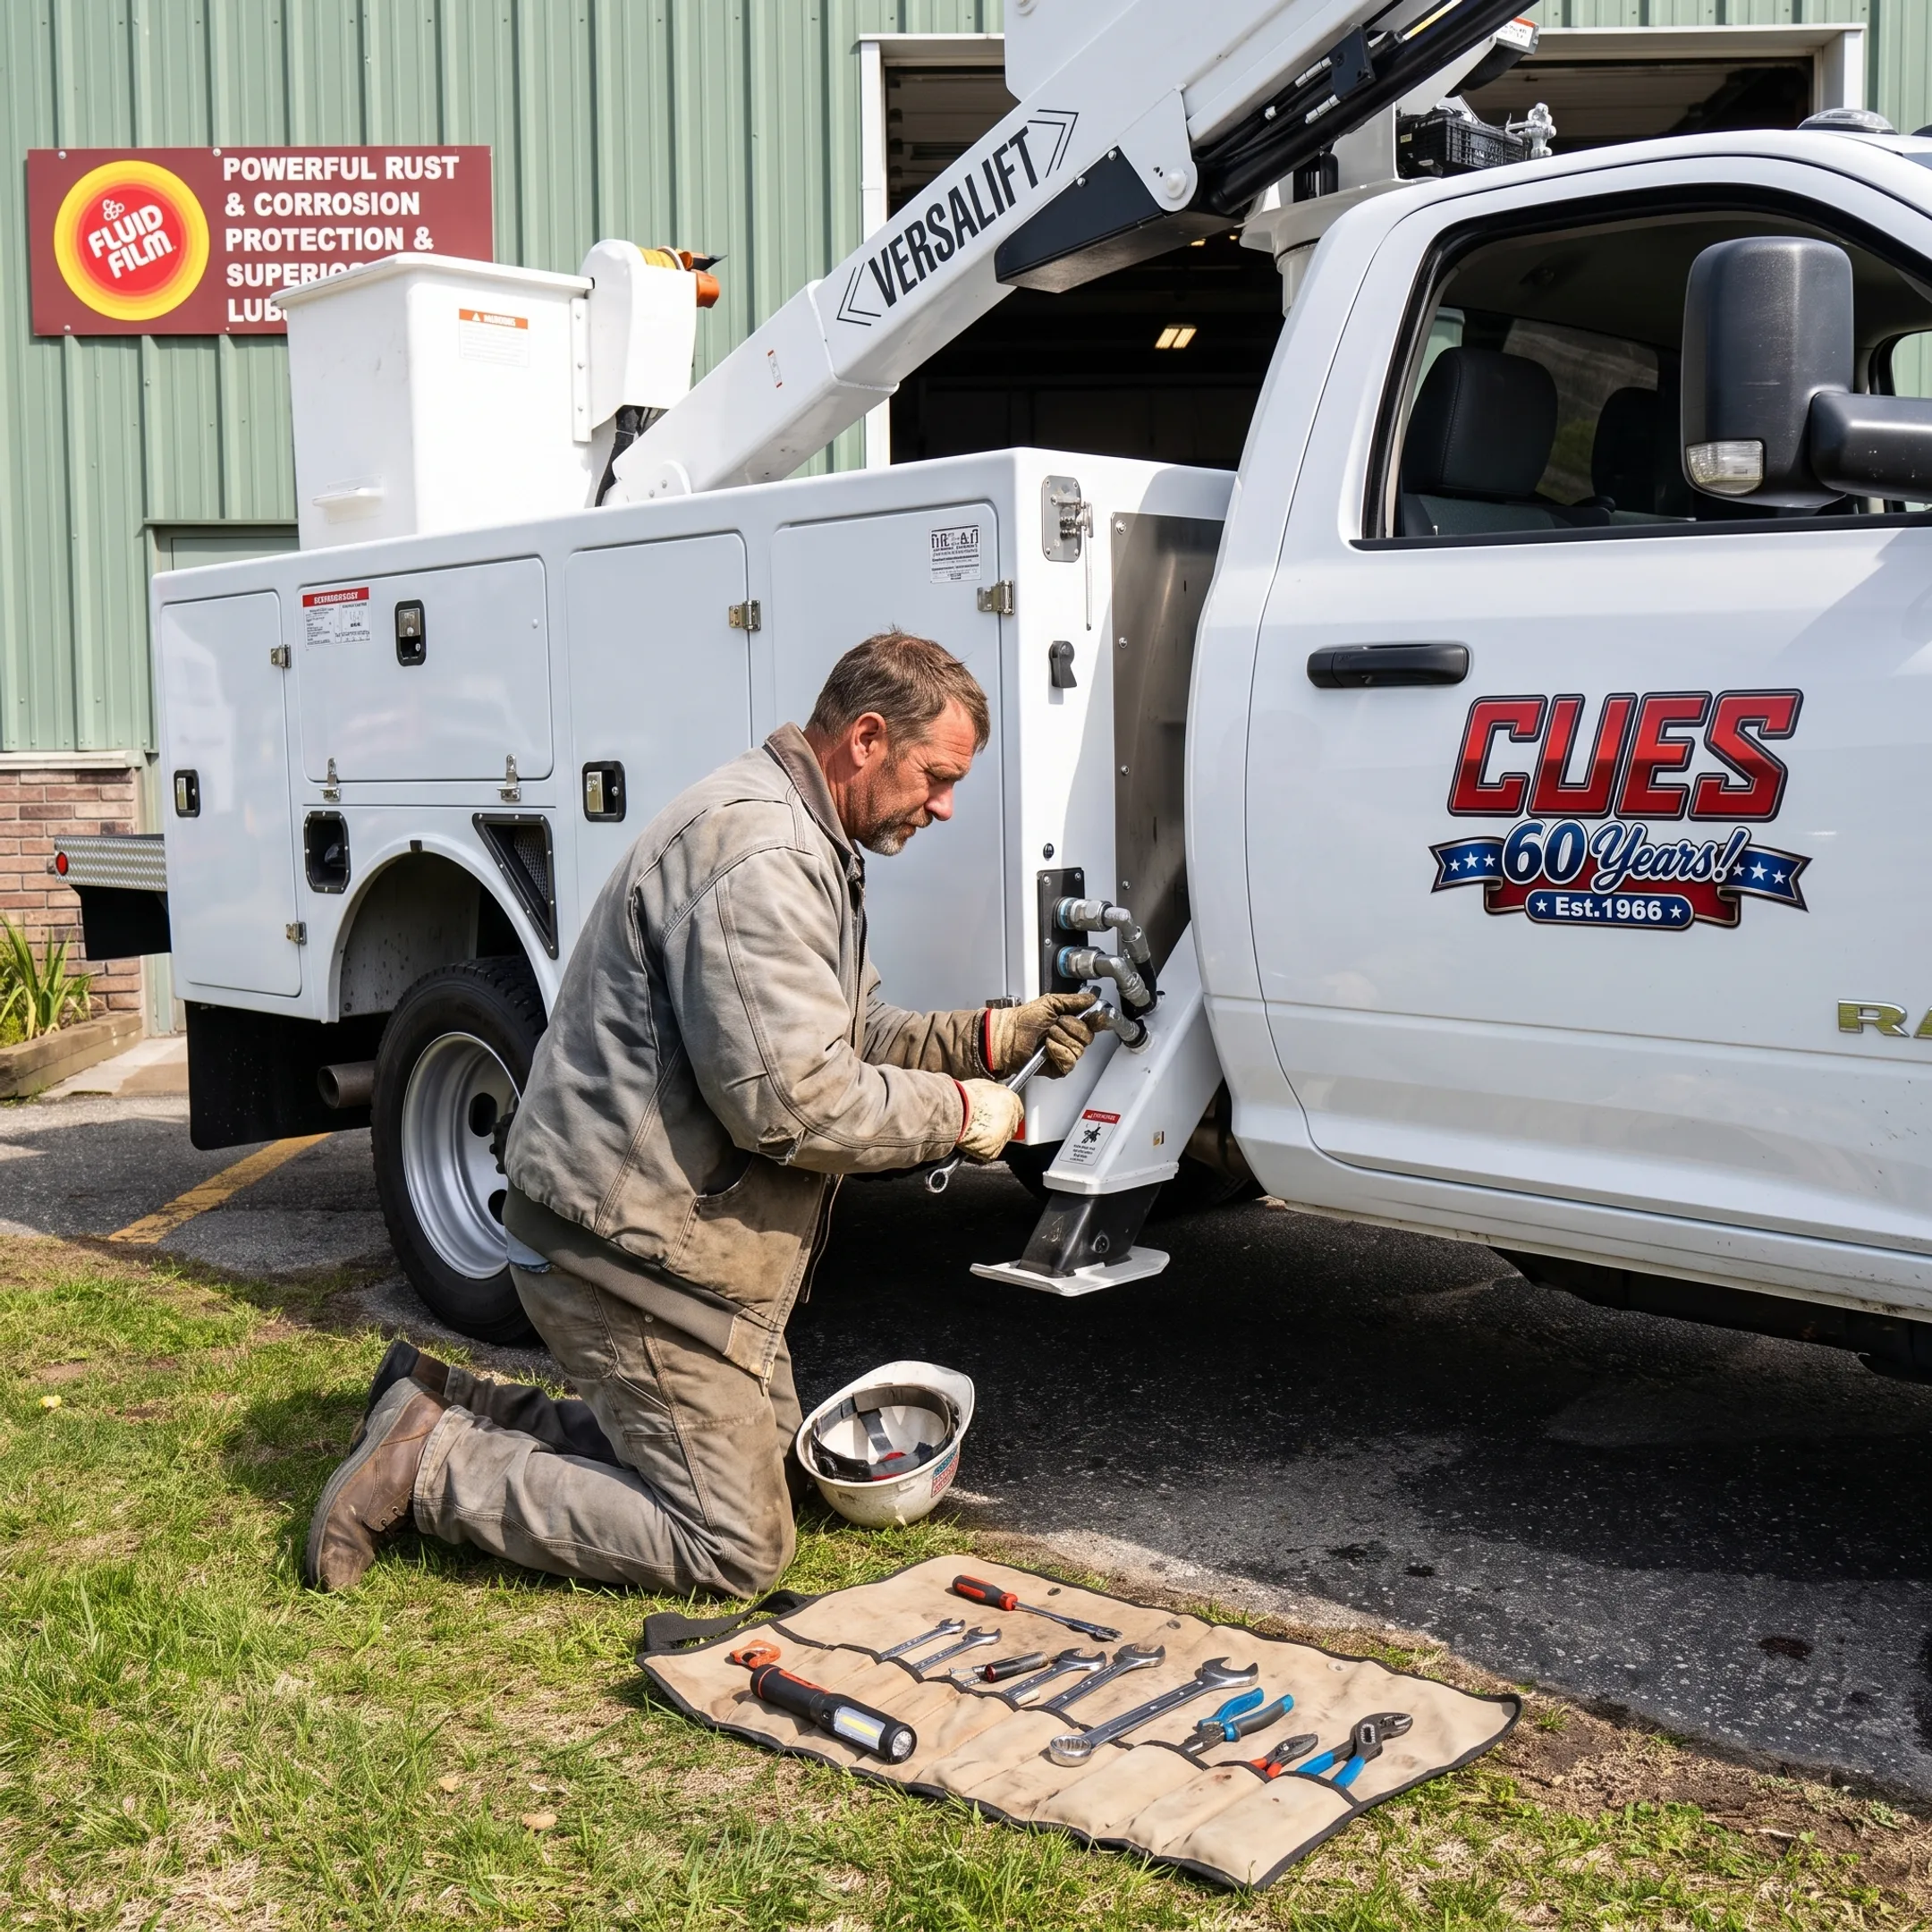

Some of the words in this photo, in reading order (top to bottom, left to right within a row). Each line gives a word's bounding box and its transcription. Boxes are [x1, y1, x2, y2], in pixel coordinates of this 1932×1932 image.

[223, 156, 377, 181] POWERFUL
[386, 156, 460, 180] RUST
[225, 192, 246, 216] &
[254, 191, 420, 216] CORROSION
[868, 125, 1039, 309] VERSALIFT
[88, 204, 164, 258] FLUID
[225, 227, 404, 251] PROTECTION
[413, 226, 435, 250] &
[107, 229, 174, 279] FILM
[226, 262, 365, 287] SUPERIO
[228, 298, 288, 322] LUB
[1446, 687, 1805, 822] CUES
[1501, 818, 1589, 885] 60
[1589, 819, 1751, 894] Years!
[1838, 998, 1932, 1039] R
